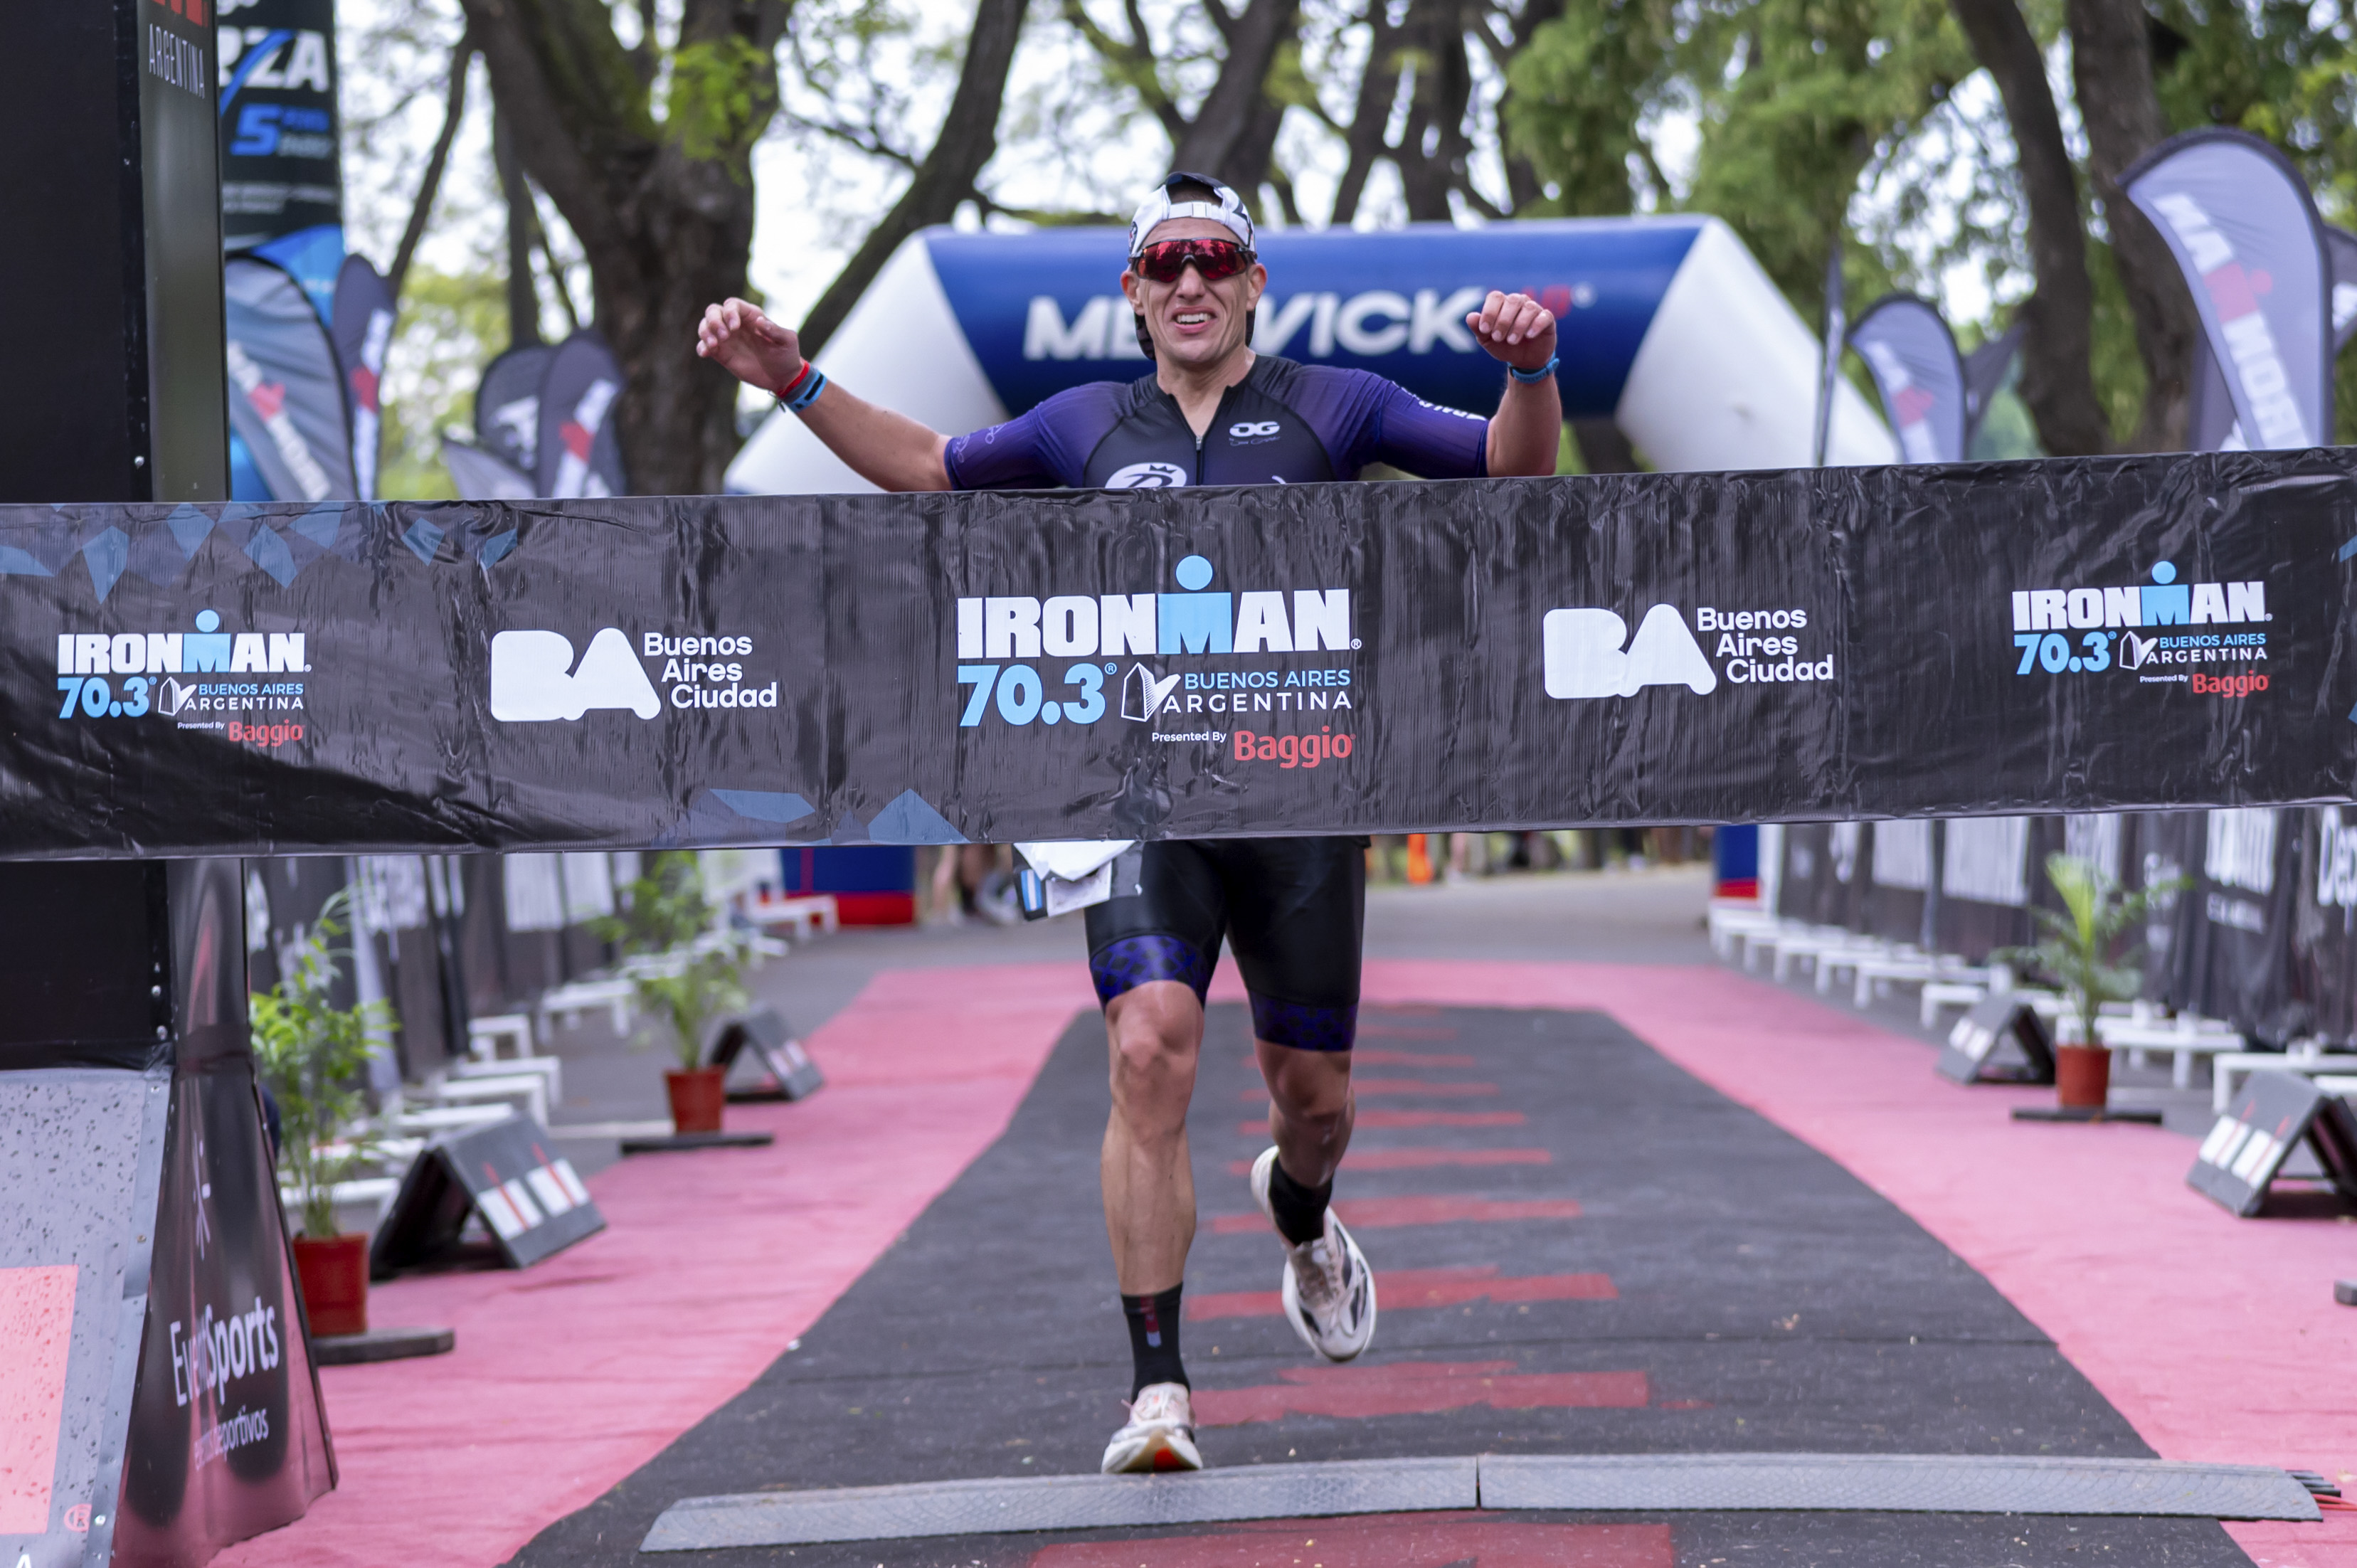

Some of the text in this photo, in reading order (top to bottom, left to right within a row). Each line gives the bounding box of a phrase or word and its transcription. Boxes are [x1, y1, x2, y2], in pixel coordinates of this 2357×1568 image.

[148, 23, 205, 100] ARGENTINA
[1023, 286, 1483, 361] MEVICK
[1229, 421, 1281, 437] OG
[1697, 607, 1807, 631] Buenos
[2012, 581, 2266, 631] IRONMAN
[958, 589, 1350, 659] IRONMAN
[58, 633, 305, 674] IRONMAN
[644, 632, 753, 656] Buenos
[1543, 603, 1717, 699] BA
[1716, 632, 1798, 657] Aires
[2014, 632, 2111, 674] 70.3
[2160, 632, 2266, 648] BUENOS AIRES
[2146, 647, 2267, 664] ARGENTINA
[491, 627, 661, 721] BA
[661, 658, 743, 683] Aires
[1185, 669, 1351, 689] BUENOS AIRES
[1727, 655, 1834, 684] Ciudad
[2139, 674, 2188, 684] Presented By
[198, 683, 304, 696] BUENOS AIRES
[671, 682, 778, 709] Ciudad
[958, 662, 1106, 727] 70.3
[2192, 670, 2269, 698] Baggio
[58, 677, 149, 719] 70.3
[184, 696, 304, 711] ARGENTINA
[1162, 691, 1352, 714] ARGENTINA
[177, 721, 225, 731] Presented By
[228, 719, 303, 747] Baggio
[1152, 731, 1227, 744] Presented By
[1234, 726, 1353, 769] Baggio
